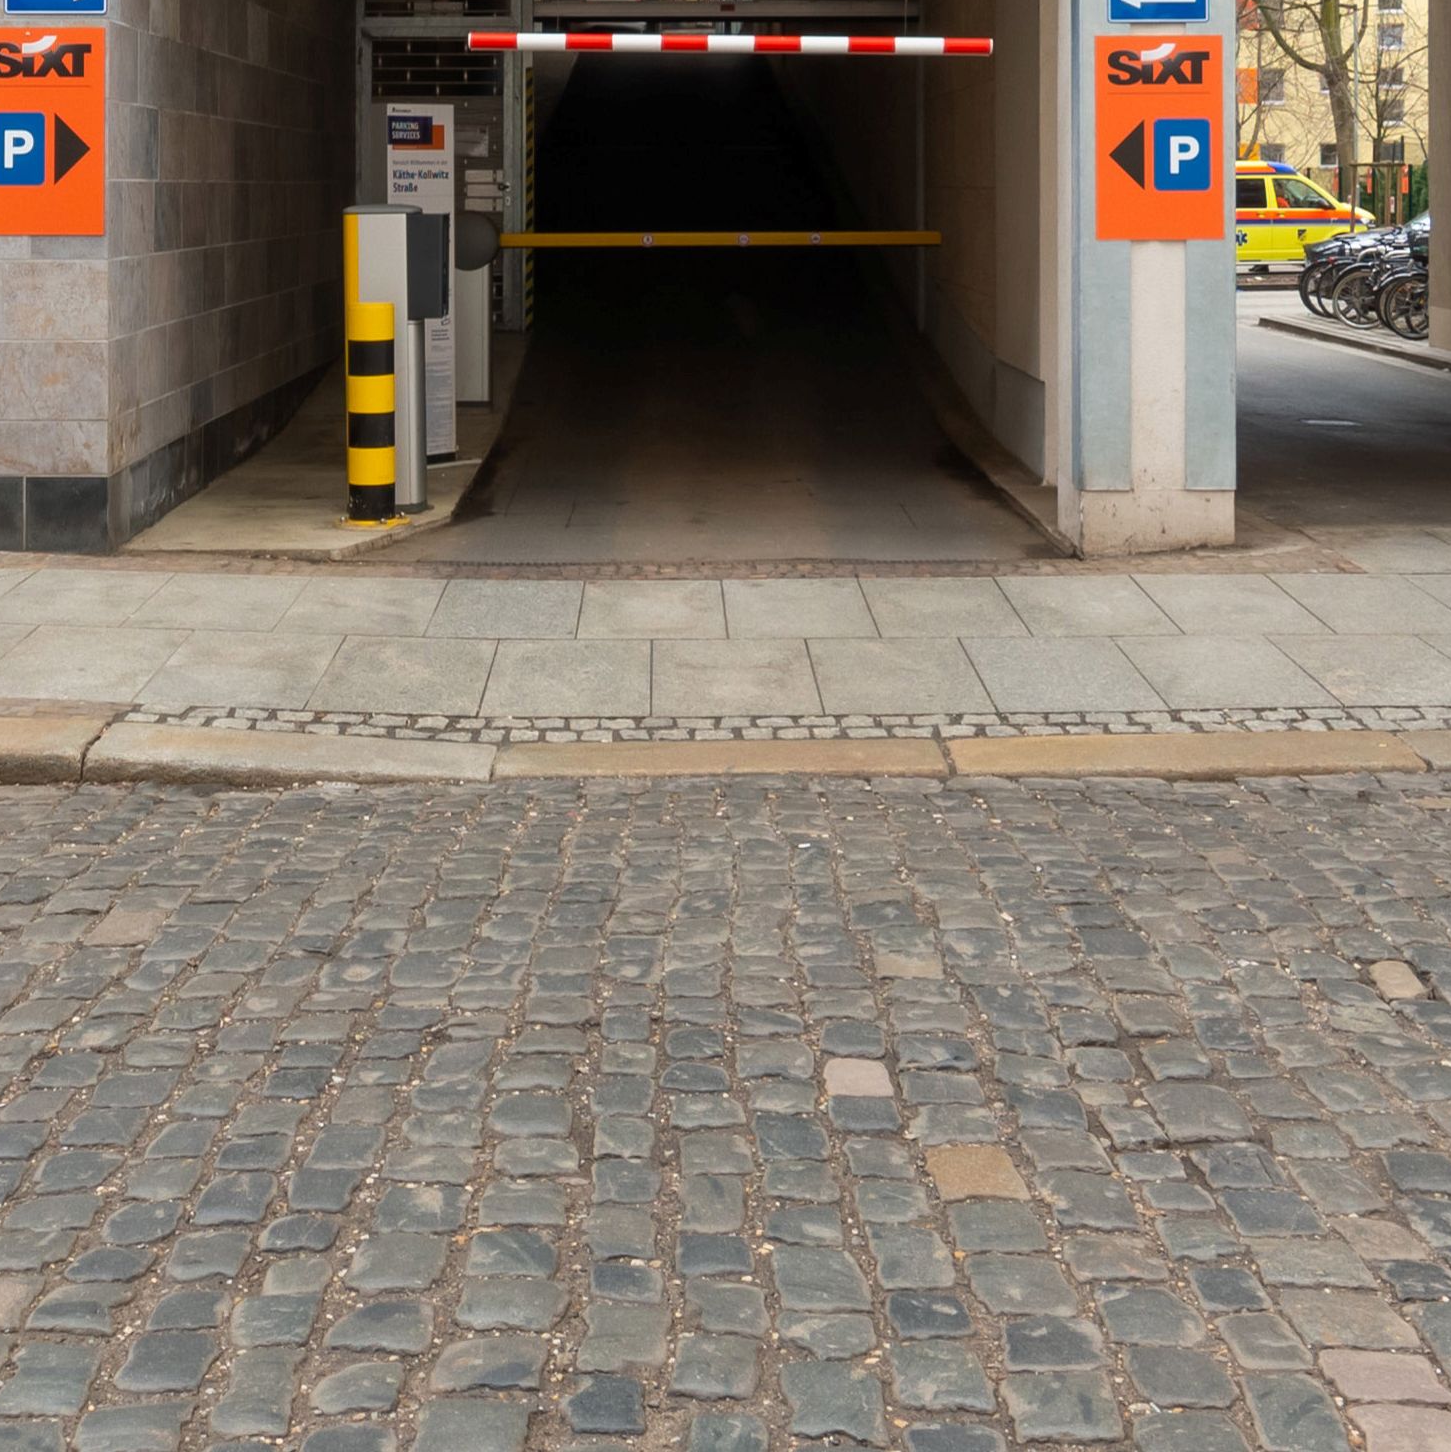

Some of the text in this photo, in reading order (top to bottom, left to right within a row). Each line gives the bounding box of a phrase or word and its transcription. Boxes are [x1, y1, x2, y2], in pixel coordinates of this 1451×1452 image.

[391, 121, 420, 131] PARKING
[391, 131, 421, 141] SERVICES
[3, 129, 35, 169] P
[1168, 135, 1200, 175] P
